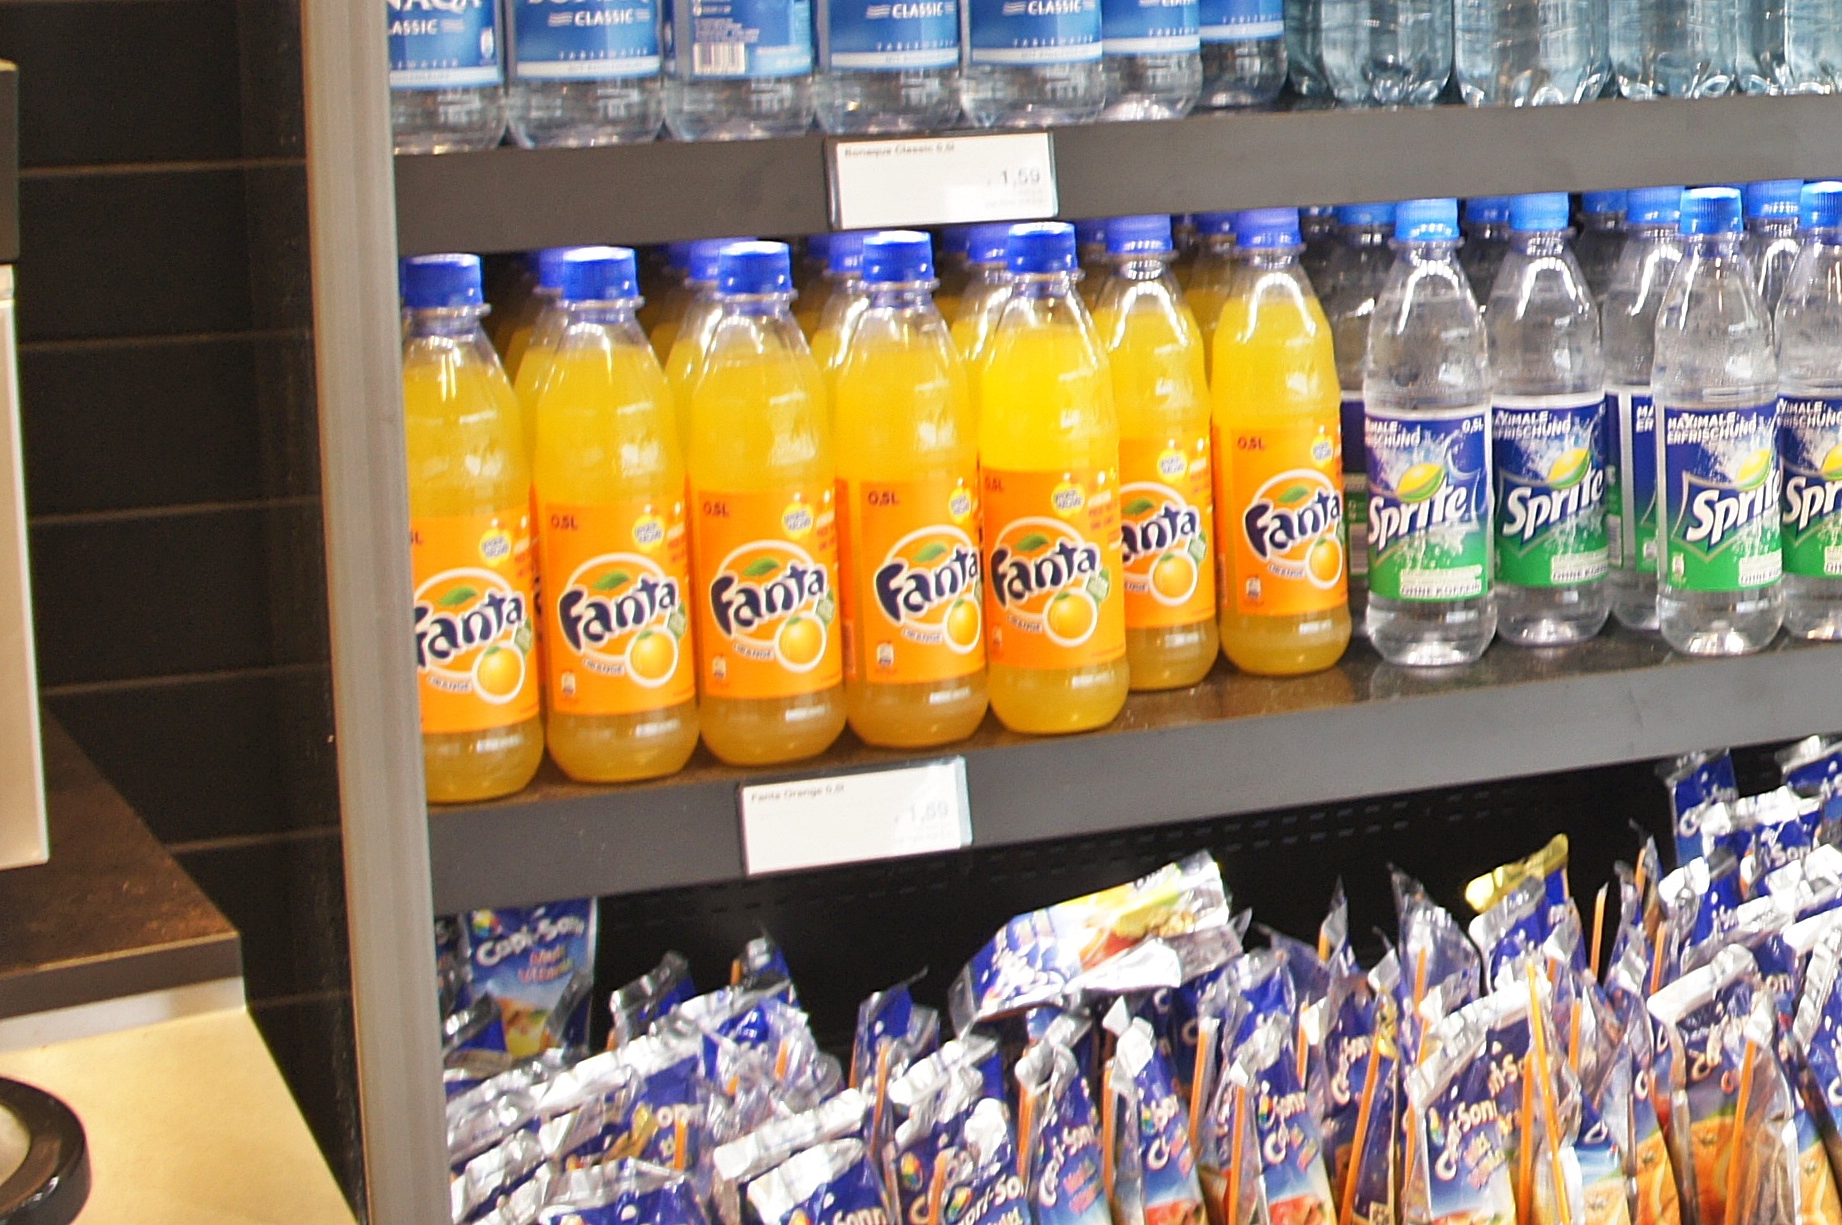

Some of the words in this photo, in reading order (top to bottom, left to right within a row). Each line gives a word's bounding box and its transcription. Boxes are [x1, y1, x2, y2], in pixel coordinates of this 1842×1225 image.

[574, 8, 634, 27] CLASSIC
[892, 1, 943, 20] CLASSIC
[1002, 169, 1041, 188] 1,59
[1121, 503, 1201, 564] anta
[1243, 488, 1342, 560] Fanta
[1368, 476, 1468, 552] Sprite
[1502, 464, 1603, 541] Sprite
[711, 561, 828, 638] Fanta
[990, 538, 1100, 609] Fanta
[558, 574, 679, 651] Fanta
